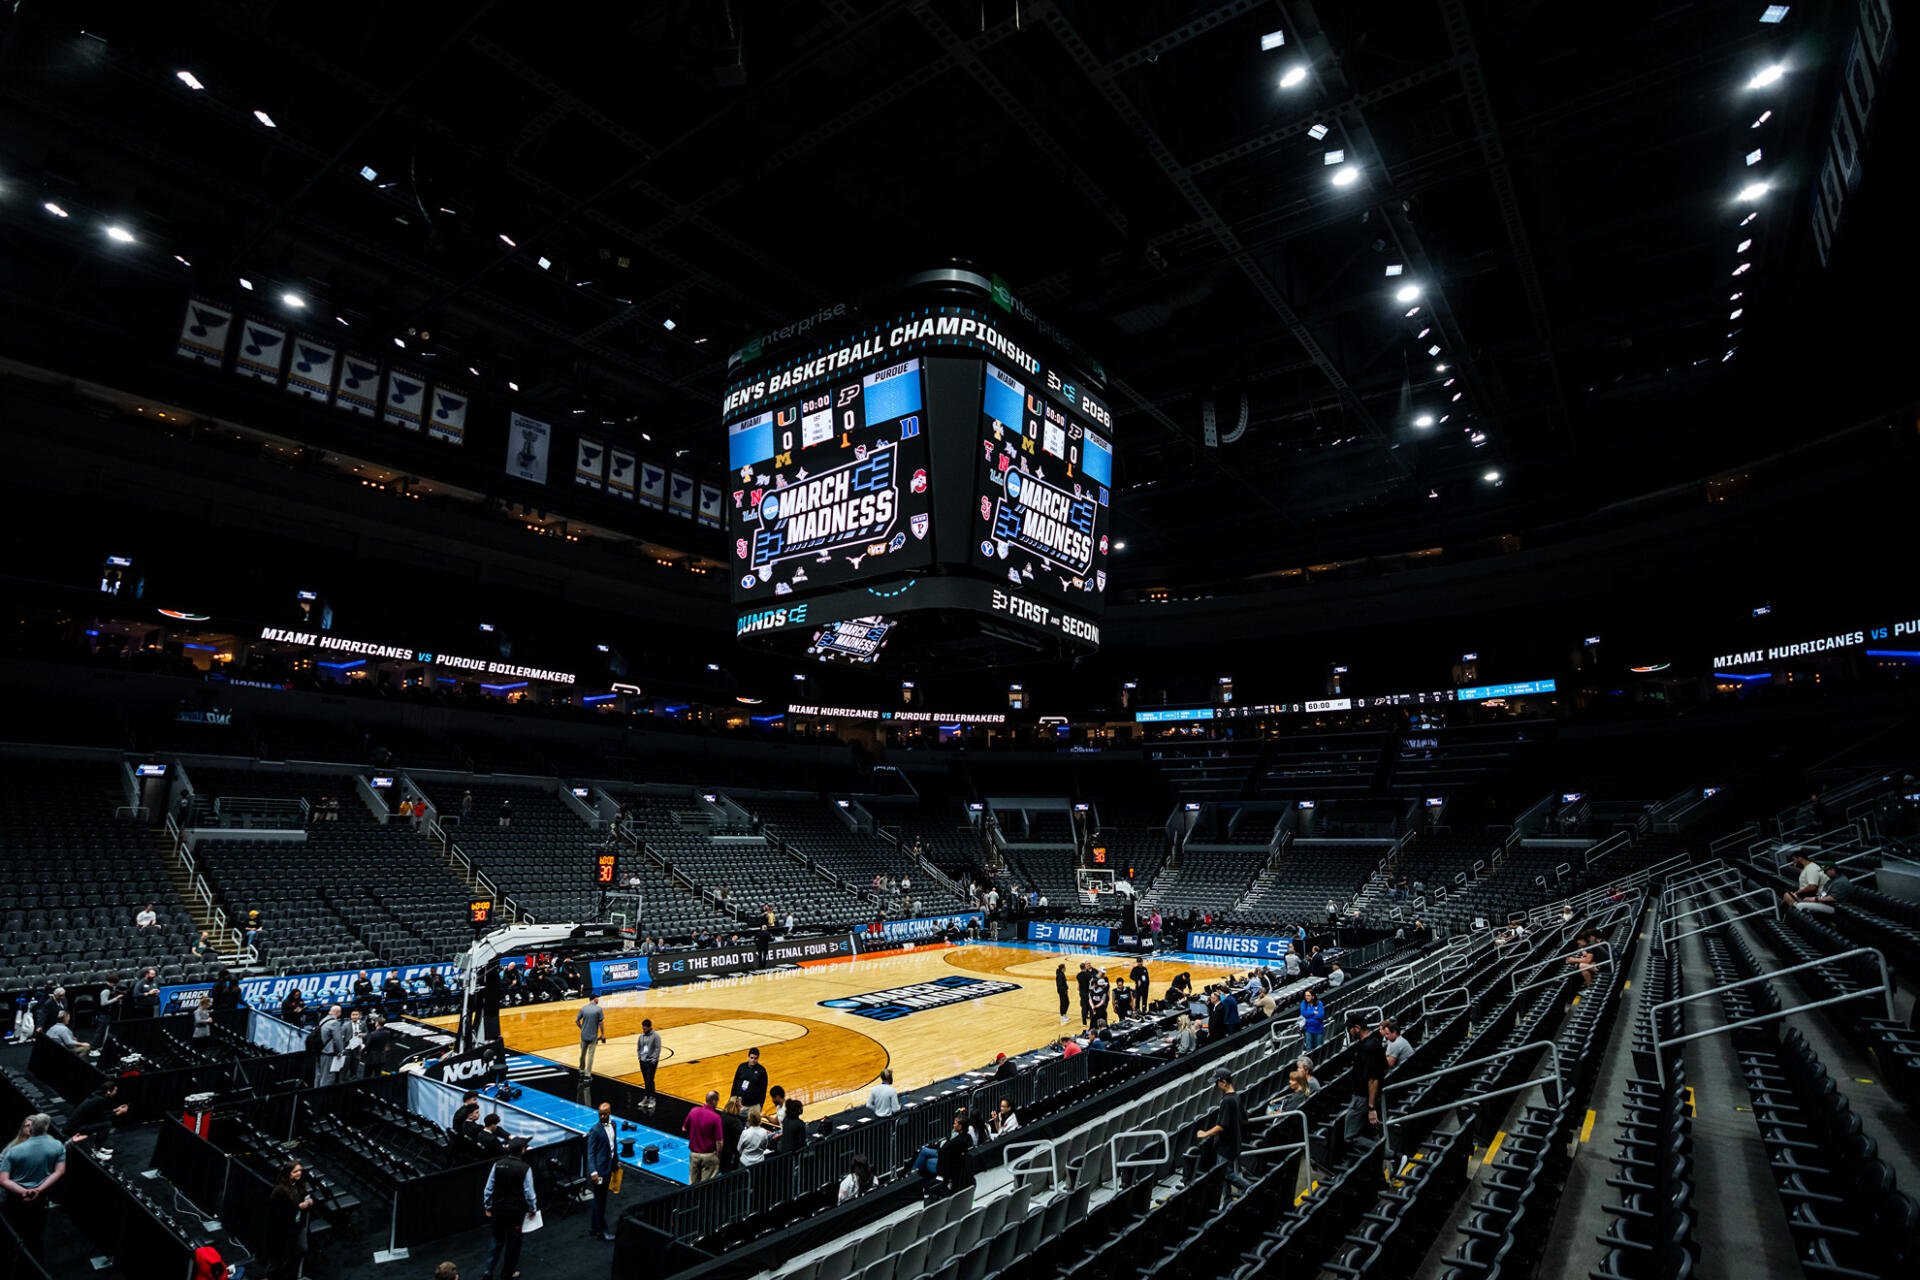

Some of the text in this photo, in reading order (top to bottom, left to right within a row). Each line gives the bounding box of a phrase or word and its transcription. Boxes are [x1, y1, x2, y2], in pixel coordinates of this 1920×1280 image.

[769, 335, 884, 394] BASKETBALL
[890, 316, 1040, 375] CHAMPIONSHIP
[874, 362, 909, 383] PURDUE
[802, 394, 830, 413] 60:00
[1082, 396, 1111, 428] 2026
[740, 416, 762, 430] MIAMI
[843, 410, 855, 430] 0
[1029, 420, 1038, 440] 0
[783, 431, 793, 450] 0
[1070, 445, 1078, 464] 0
[779, 470, 850, 519] MARCH
[1019, 478, 1071, 524] MARCH
[787, 489, 895, 545] MADNESS
[1022, 509, 1092, 563] MADNESS
[836, 622, 870, 639] MARCH
[1010, 596, 1049, 625] FIRST
[1062, 615, 1100, 646] SECON
[835, 634, 877, 652] MADNESS
[1713, 650, 1764, 669] MIAMI
[1768, 631, 1864, 660] HURRICANES
[1871, 627, 1888, 640] VS
[261, 627, 576, 684] MIAMI HURRICANES VS PURDUE BOILERMAKERS
[788, 704, 1005, 723] MIAMI HURRICANES VS PURDUE BOILERMAKERS
[1308, 702, 1330, 711] 60:00
[600, 865, 612, 881] 30
[474, 910, 486, 921] 30
[1058, 926, 1099, 943] MARCH
[1193, 935, 1258, 953] MADNESS
[687, 956, 708, 970] THE
[711, 953, 739, 967] ROAD
[742, 951, 755, 963] TO
[776, 947, 803, 960] FINAL
[804, 942, 828, 955] FOUR
[612, 970, 639, 979] MADNESS
[239, 980, 269, 1001] THE
[848, 982, 947, 1005] MARCH
